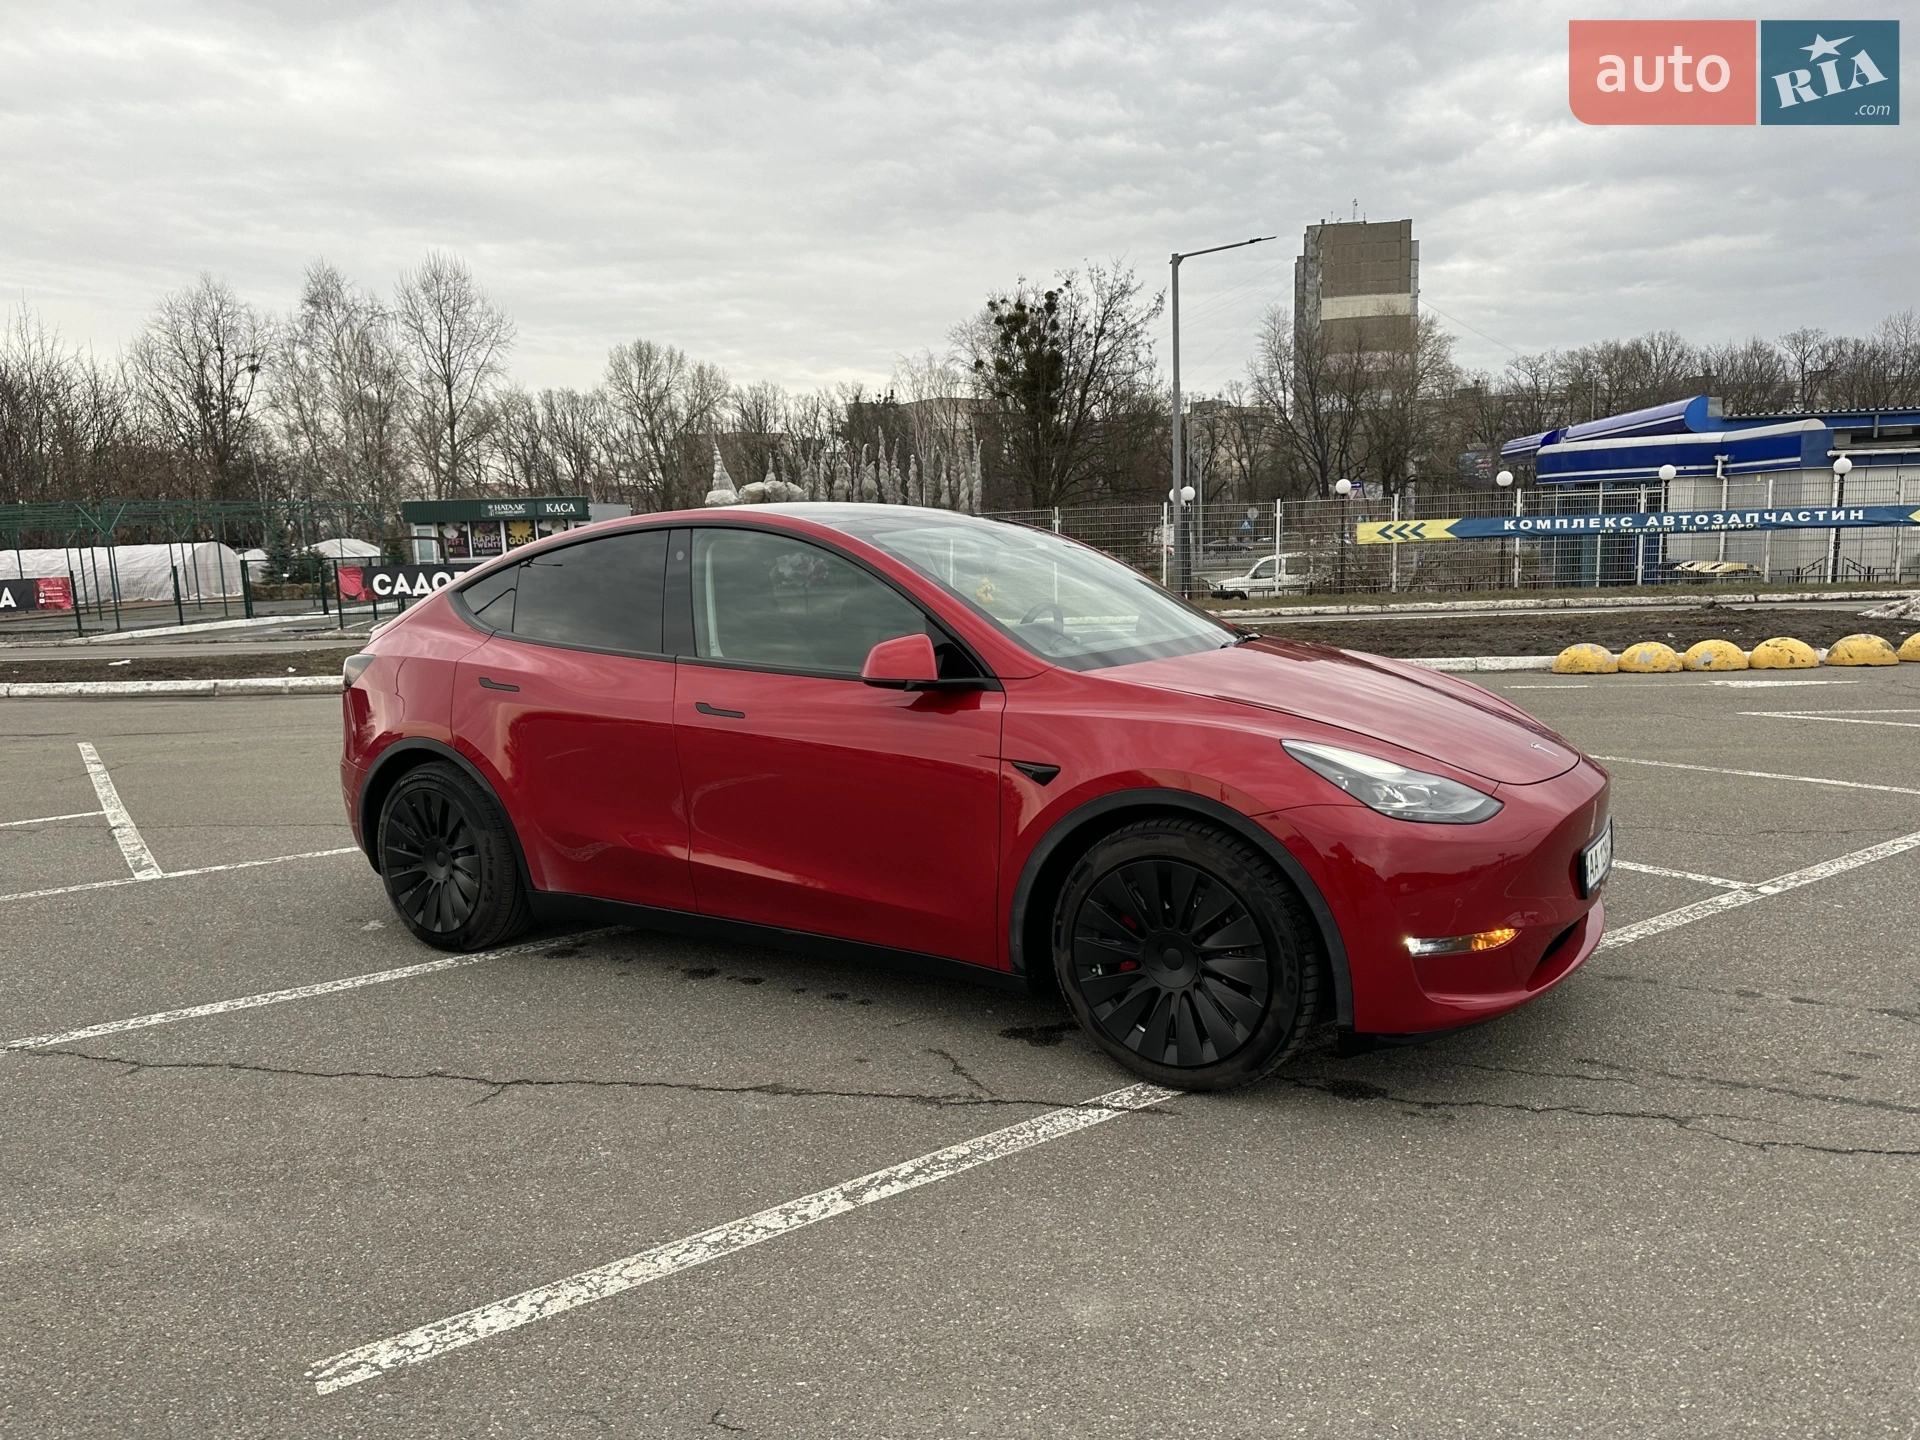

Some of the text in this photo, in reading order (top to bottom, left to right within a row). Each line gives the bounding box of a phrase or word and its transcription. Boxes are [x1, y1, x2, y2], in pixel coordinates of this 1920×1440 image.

[545, 502, 576, 513] КАСА
[1504, 509, 1864, 530] КОМПЛЕКС АВТОЗАПЧАСТИН
[1620, 525, 1675, 534] парковці
[472, 535, 501, 544] HAPPY
[509, 536, 535, 545] GOLD
